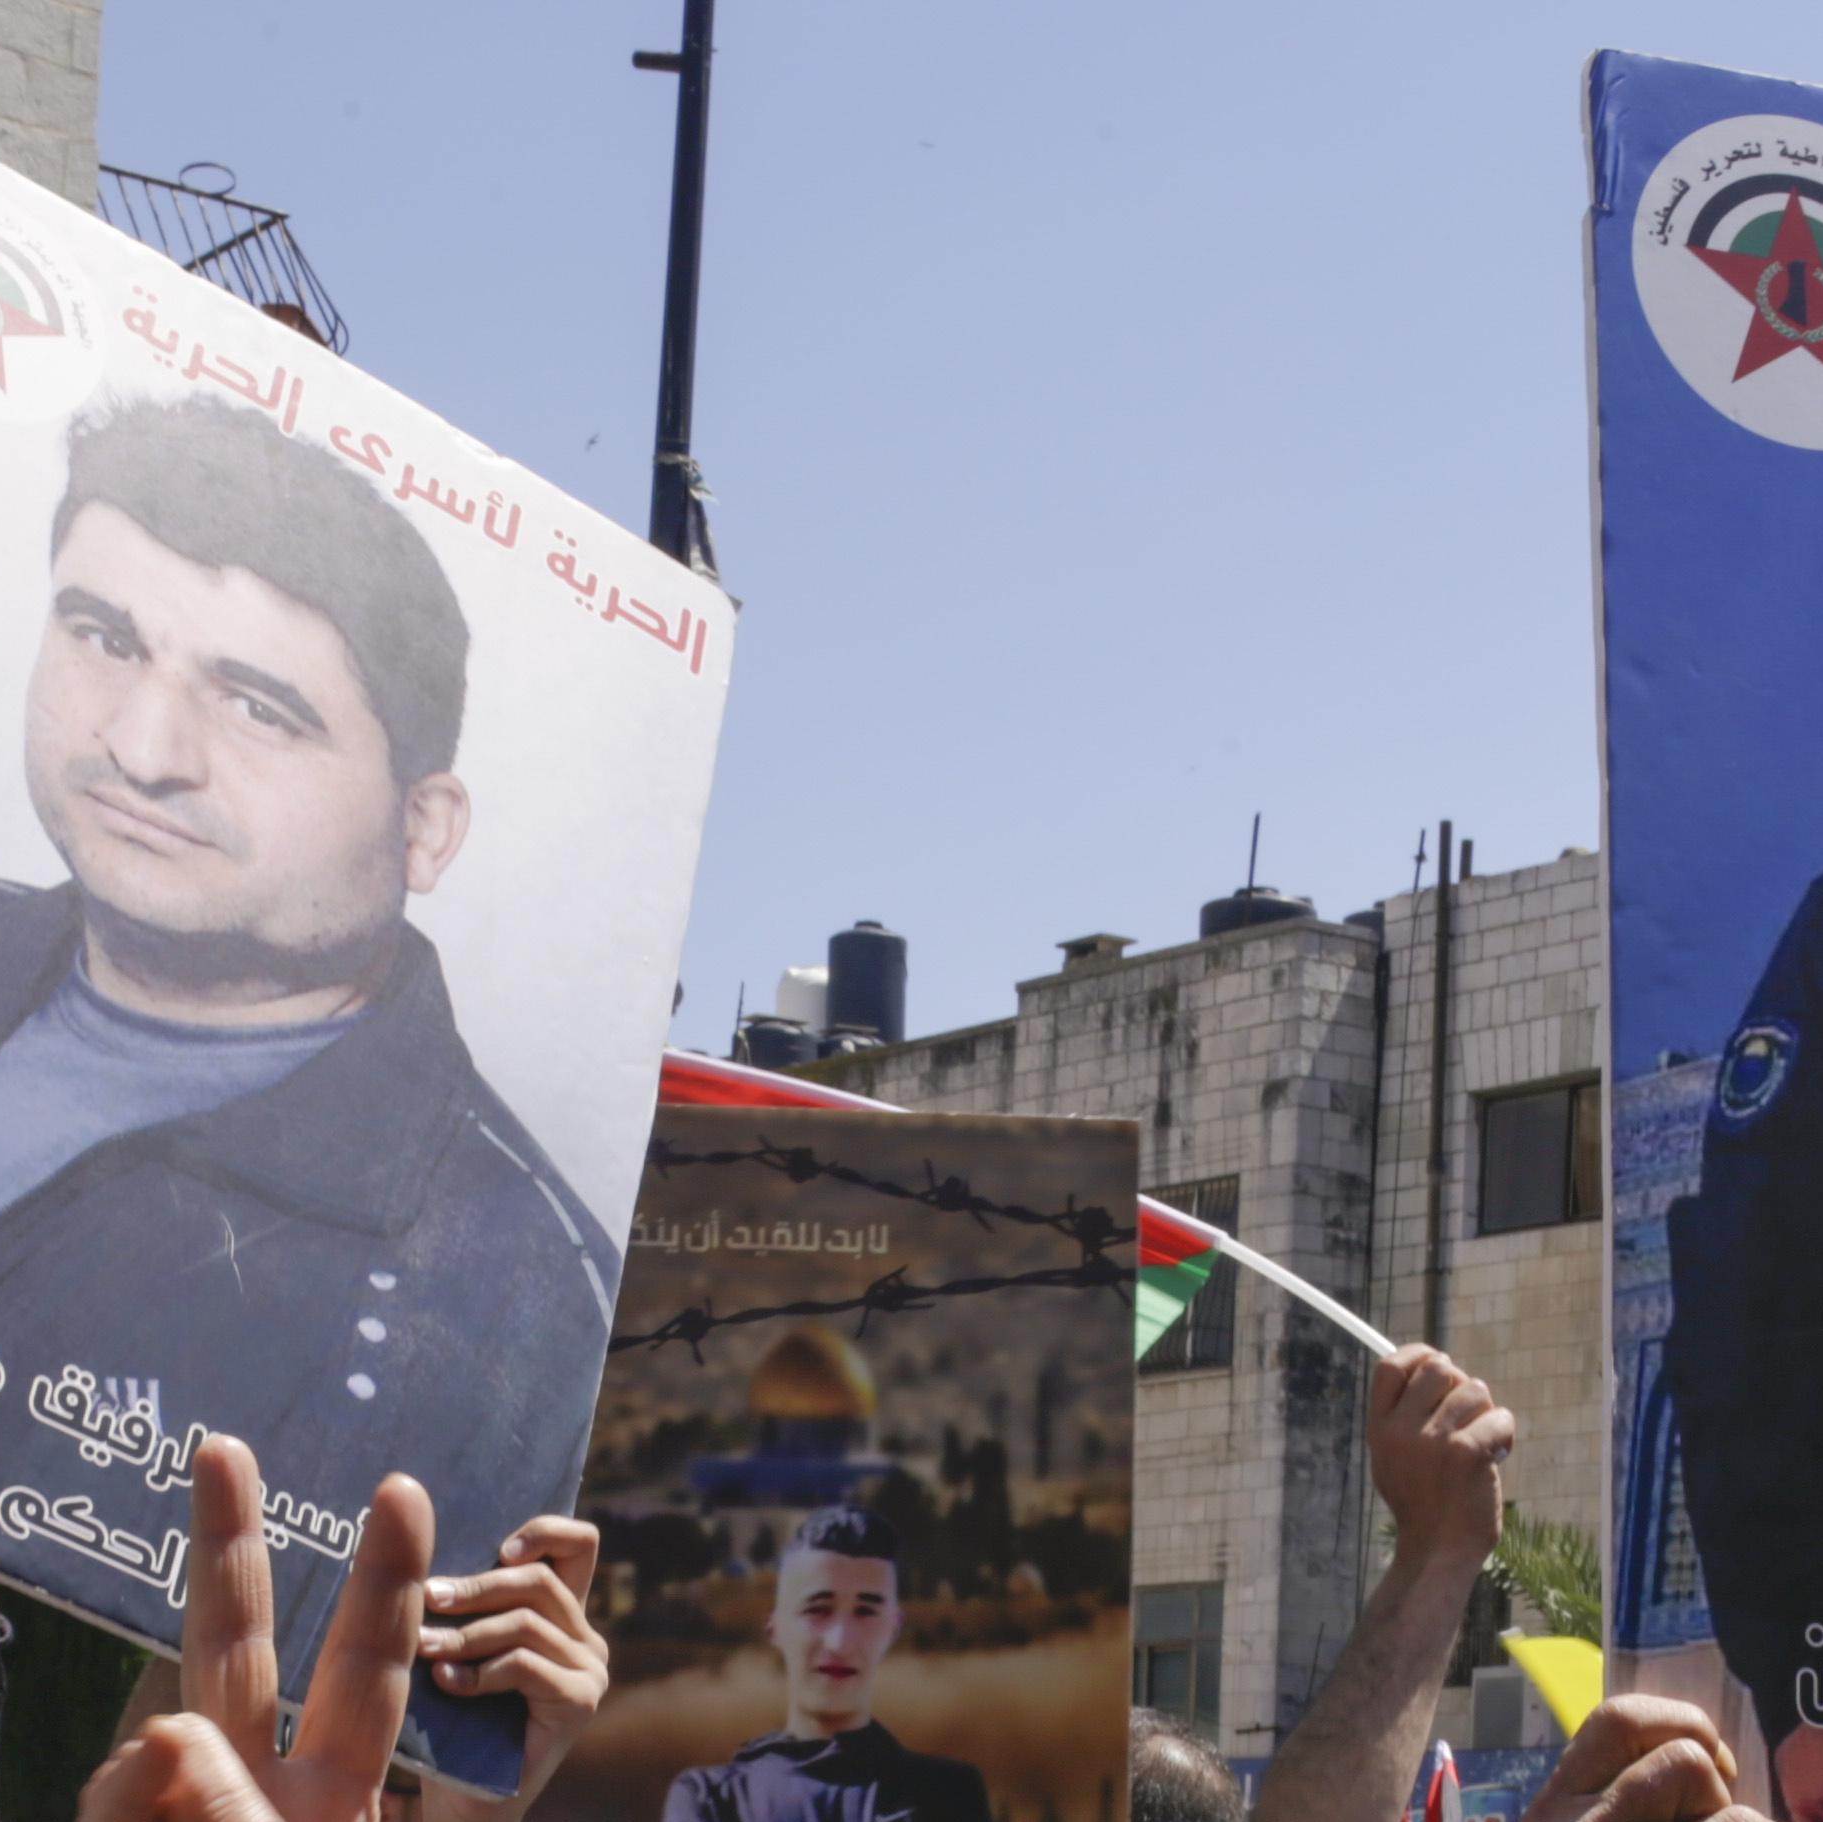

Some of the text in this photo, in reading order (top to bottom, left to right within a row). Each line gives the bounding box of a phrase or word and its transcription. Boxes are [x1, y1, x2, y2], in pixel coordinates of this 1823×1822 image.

[1701, 141, 1763, 182] لتحرير
[1649, 178, 1691, 247] فلسطين
[121, 284, 708, 677] الحرية لأسرى الحرية
[684, 1208, 720, 1253] أن
